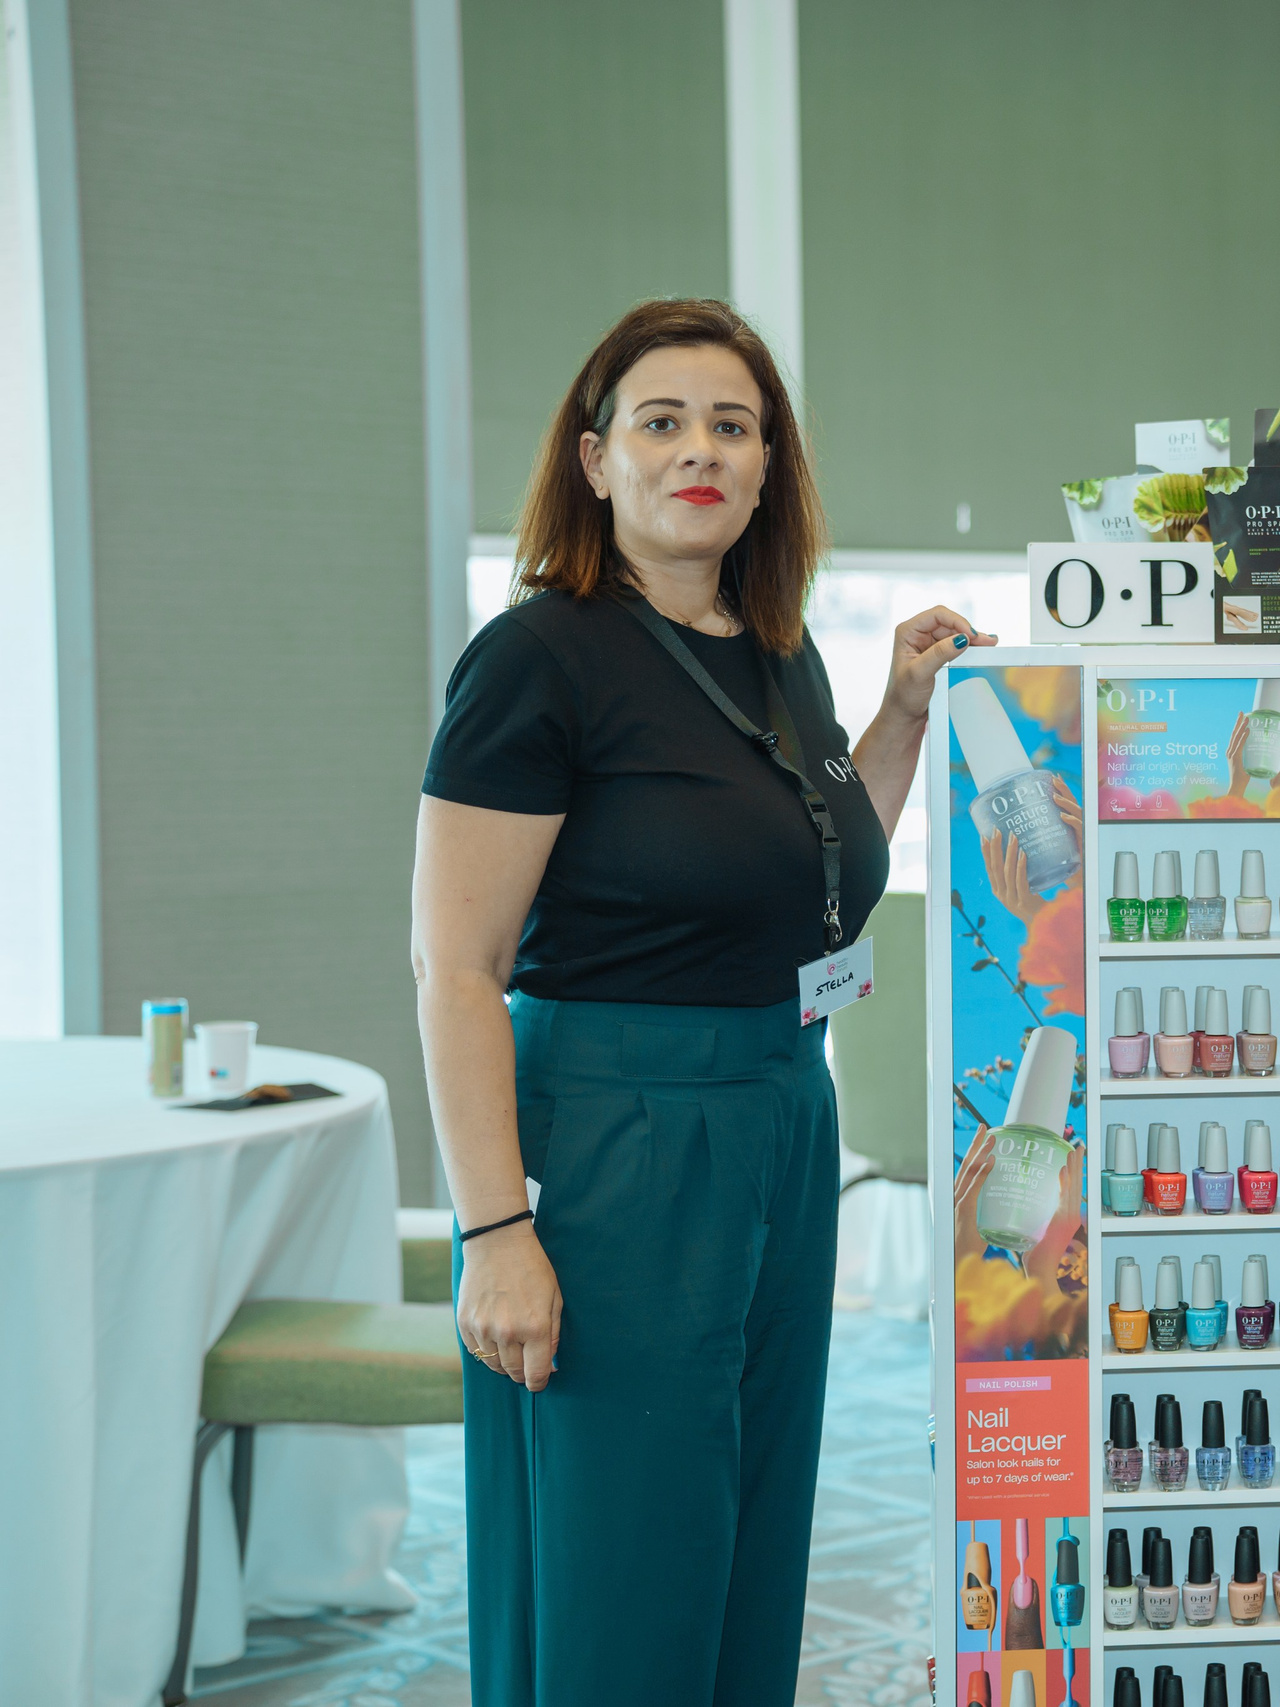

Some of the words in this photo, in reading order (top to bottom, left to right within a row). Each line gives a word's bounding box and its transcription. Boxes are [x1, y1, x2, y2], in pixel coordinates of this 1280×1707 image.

[1102, 516, 1132, 530] O·P·I
[1044, 558, 1214, 628] O·P
[1106, 689, 1176, 712] O·P·I
[1108, 743, 1161, 756] Nature
[1166, 743, 1218, 759] Strong
[1108, 762, 1145, 771] Natural
[1148, 762, 1180, 774] origin.
[1183, 762, 1218, 773] Vegan.
[1108, 777, 1122, 787] Up
[1125, 777, 1136, 785] to
[1139, 776, 1145, 785] 7
[1148, 776, 1177, 786] days
[1179, 776, 1187, 785] of
[992, 781, 1048, 815] O·P·I
[1006, 804, 1048, 828] nature
[1014, 816, 1049, 835] strong
[815, 972, 854, 996] STELLA
[999, 1138, 1054, 1166] O·P·I
[1000, 1162, 1045, 1179] nature
[1003, 1173, 1038, 1189] strong
[979, 1381, 1001, 1389] NAIL
[1004, 1380, 1038, 1388] POLISH
[968, 1407, 1009, 1428] Nail
[968, 1434, 1066, 1456] Lacquer
[967, 1460, 995, 1469] Salon
[997, 1459, 1019, 1468] look
[1021, 1458, 1044, 1468] nails
[1046, 1457, 1061, 1466] for
[967, 1476, 980, 1486] up
[982, 1475, 993, 1483] to
[996, 1474, 1002, 1483] 7
[1004, 1473, 1029, 1484] days
[1031, 1472, 1041, 1482] of
[968, 1595, 989, 1603] O·P·I
